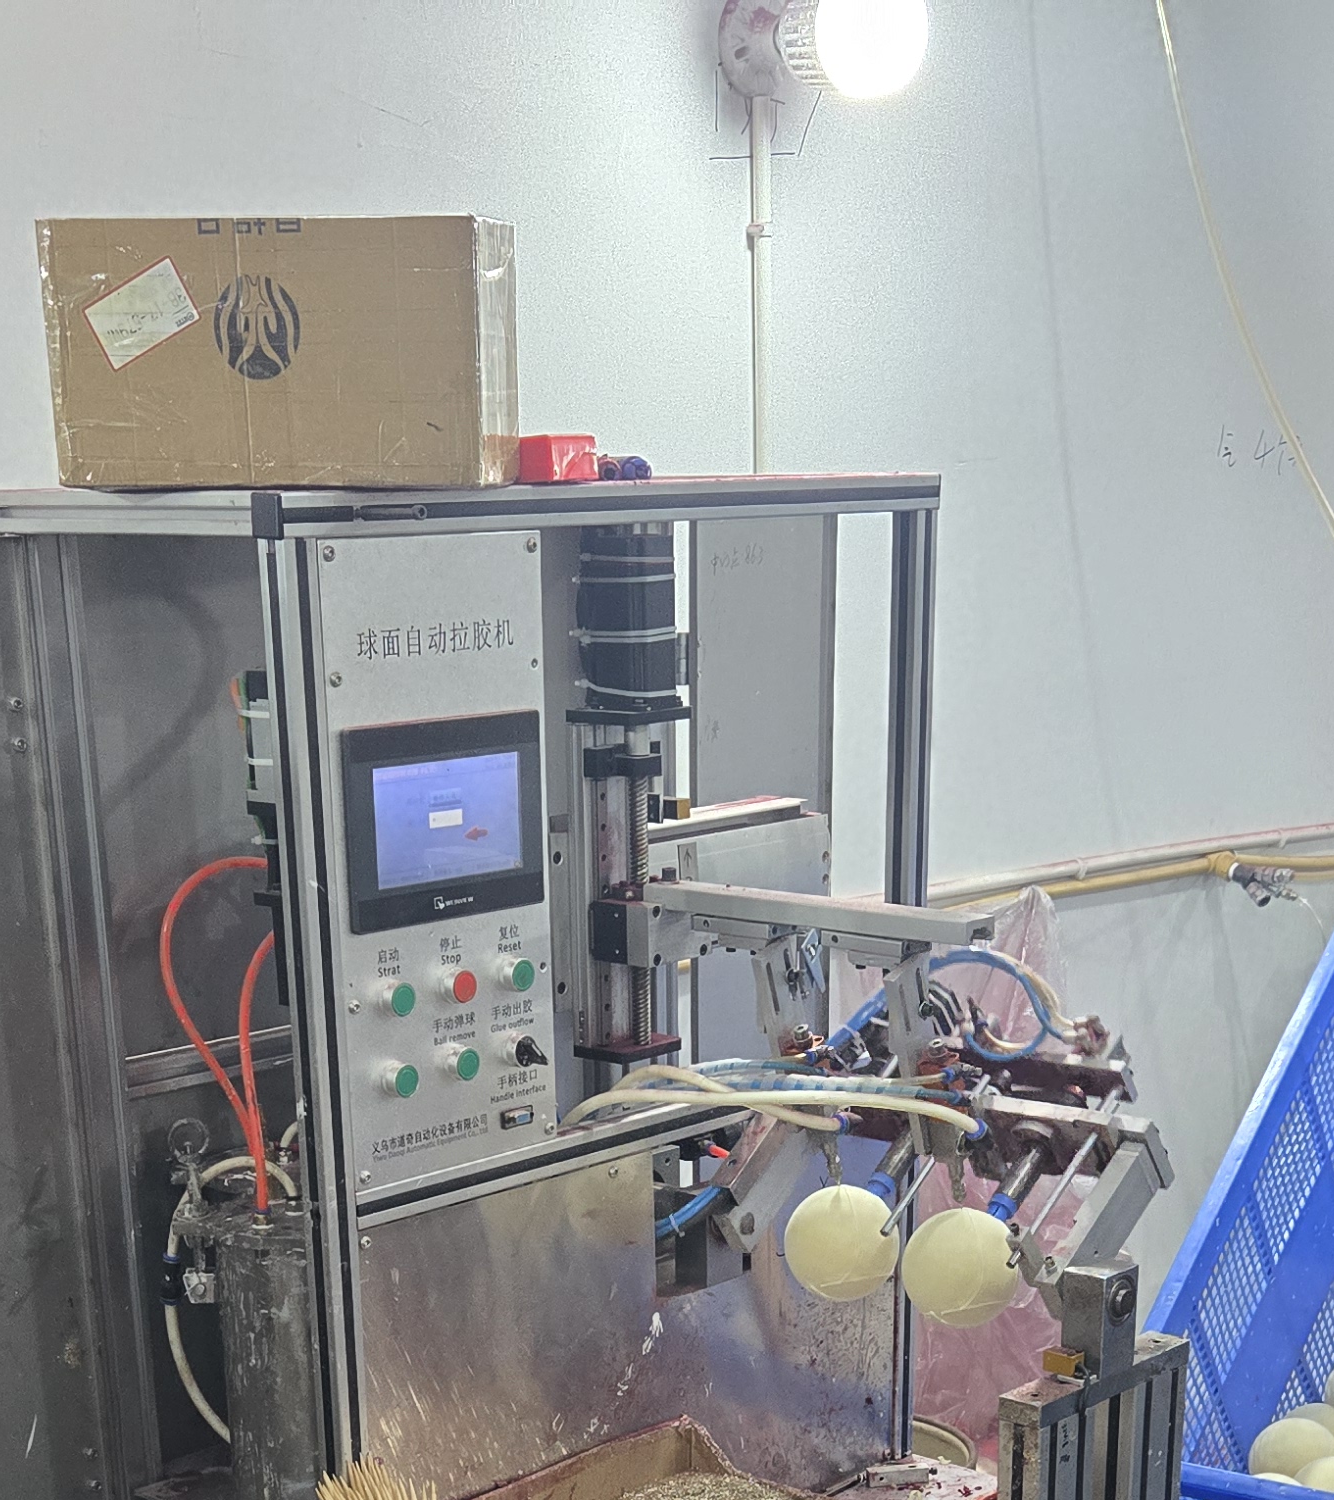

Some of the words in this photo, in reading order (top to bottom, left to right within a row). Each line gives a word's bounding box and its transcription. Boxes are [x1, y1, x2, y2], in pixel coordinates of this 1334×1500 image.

[356, 618, 515, 661] 球面自动拉胶机
[498, 923, 520, 941] 复位
[439, 935, 463, 953] 停止
[497, 940, 522, 954] Reset
[377, 947, 400, 965] 启动
[441, 952, 462, 966] Stop
[378, 964, 401, 978] Strat
[491, 998, 534, 1021] 手动出胶
[432, 1011, 477, 1034] 手动弹球
[490, 1021, 507, 1033] Glue
[508, 1016, 535, 1030] outflow
[433, 1035, 447, 1046] Ball
[448, 1030, 476, 1044] remove
[496, 1069, 539, 1091] 手柄接口
[490, 1091, 515, 1105] Handle
[515, 1084, 547, 1099] interface
